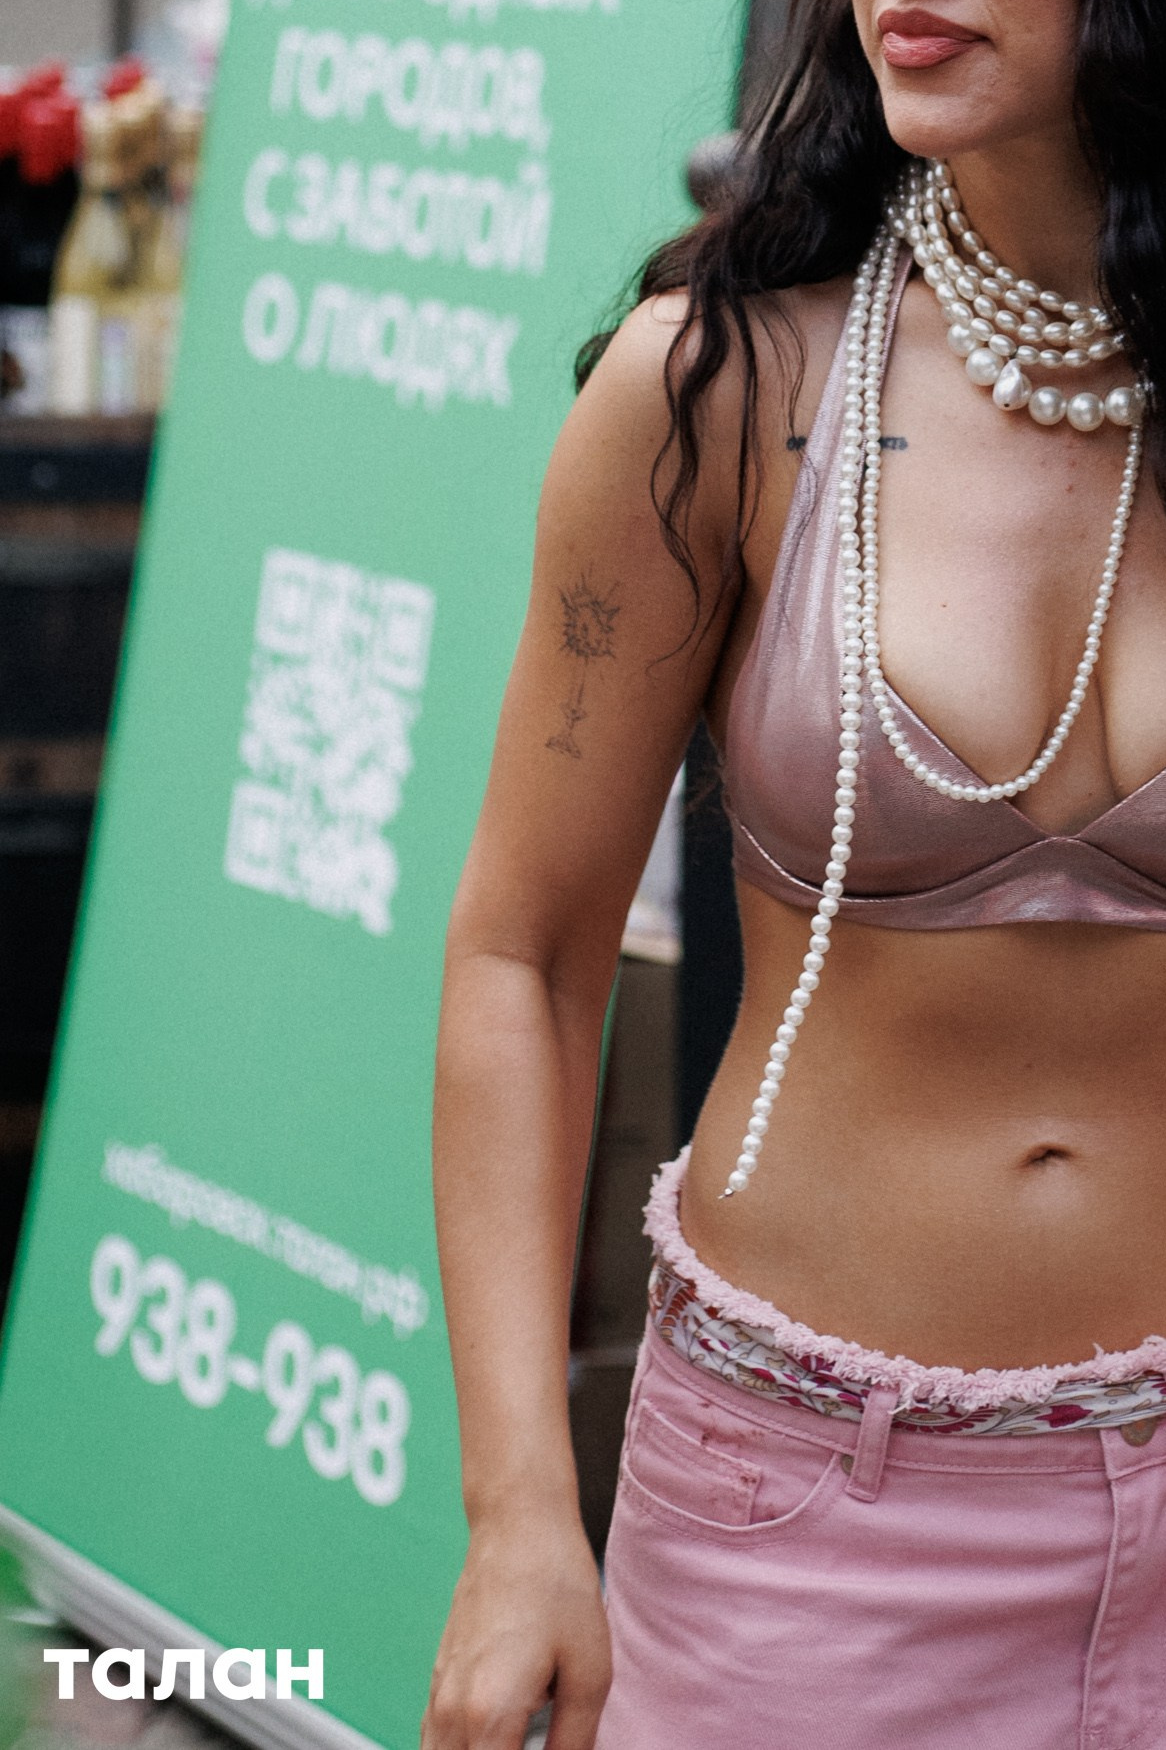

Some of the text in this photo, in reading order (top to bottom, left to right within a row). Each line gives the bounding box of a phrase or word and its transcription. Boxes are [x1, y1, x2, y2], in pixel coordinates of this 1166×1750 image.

[243, 146, 551, 276] С ЗАБОТОЙ
[242, 272, 521, 411] О ЛЮДЯХ
[91, 1235, 410, 1506] 938-938
